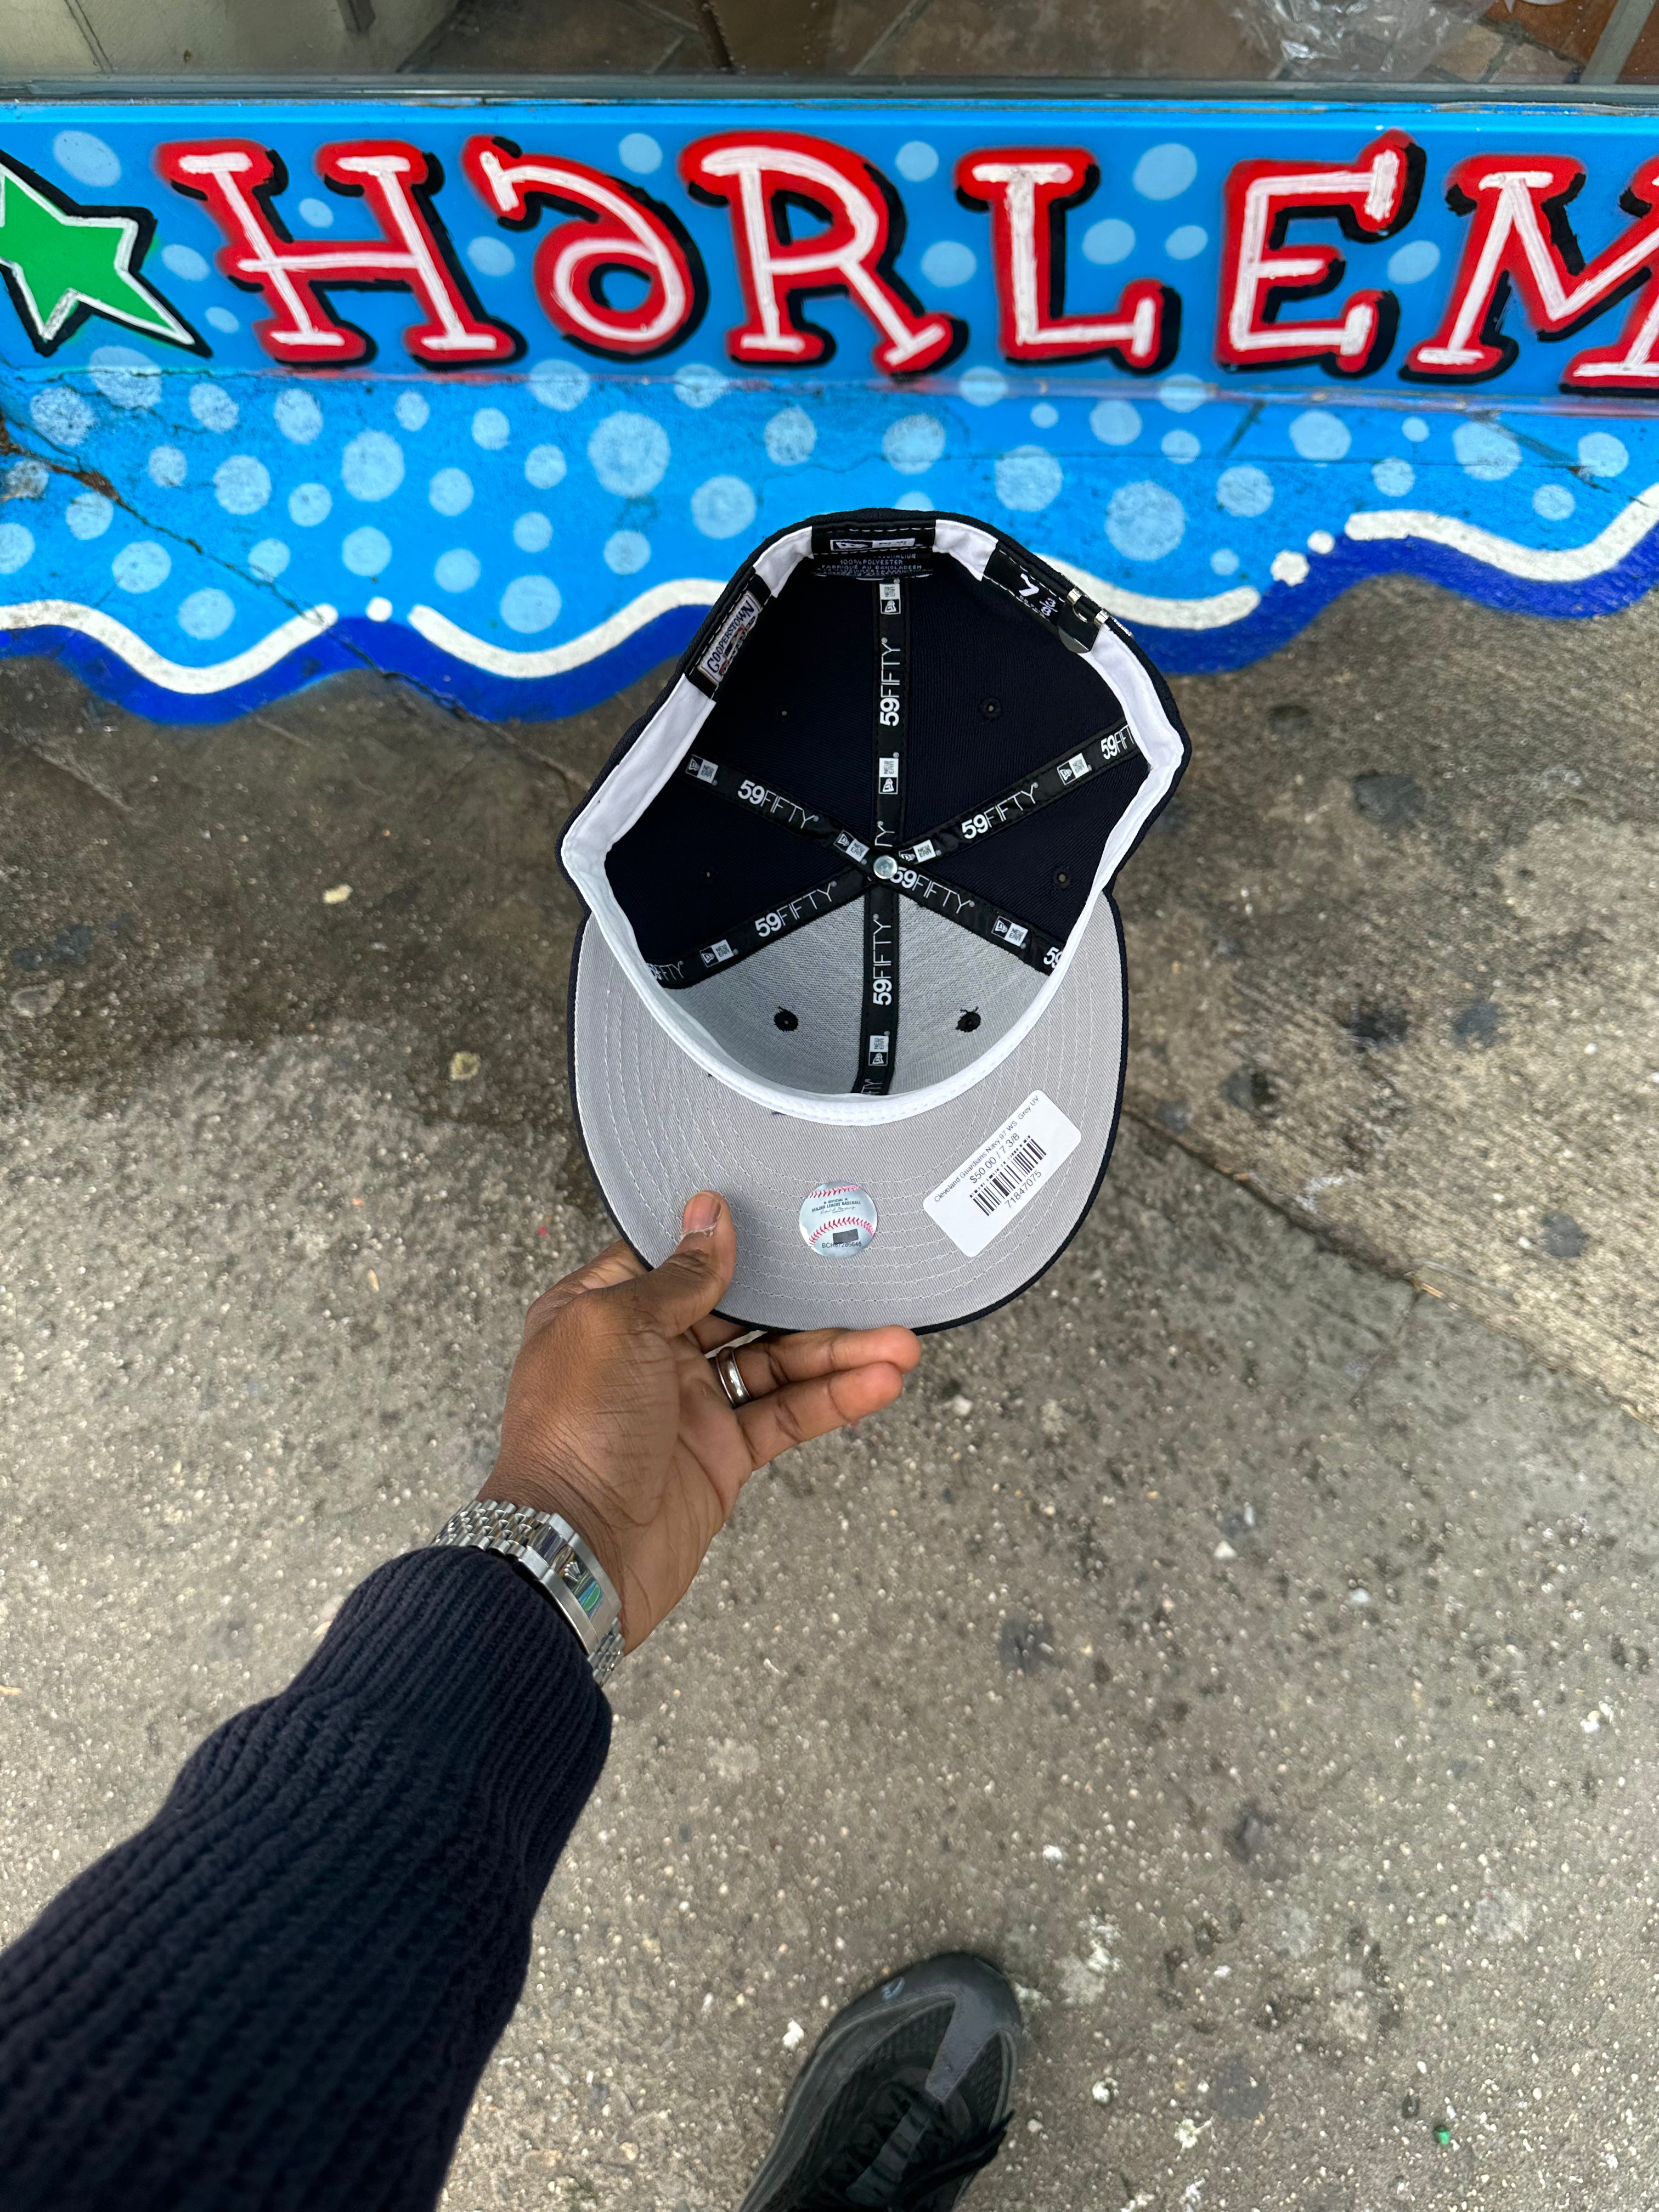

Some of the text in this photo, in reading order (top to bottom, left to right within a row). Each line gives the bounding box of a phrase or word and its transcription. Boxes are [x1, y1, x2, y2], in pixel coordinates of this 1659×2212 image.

[1018, 573, 1040, 597] 7
[706, 599, 755, 673] COOPERSTOWN
[934, 1095, 1039, 1202] Cleveland Guardians Navy 97 WS Grey UV
[999, 1145, 1006, 1153] 7
[1006, 1133, 1019, 1147] 3/8
[1005, 1170, 1041, 1208] 71847075
